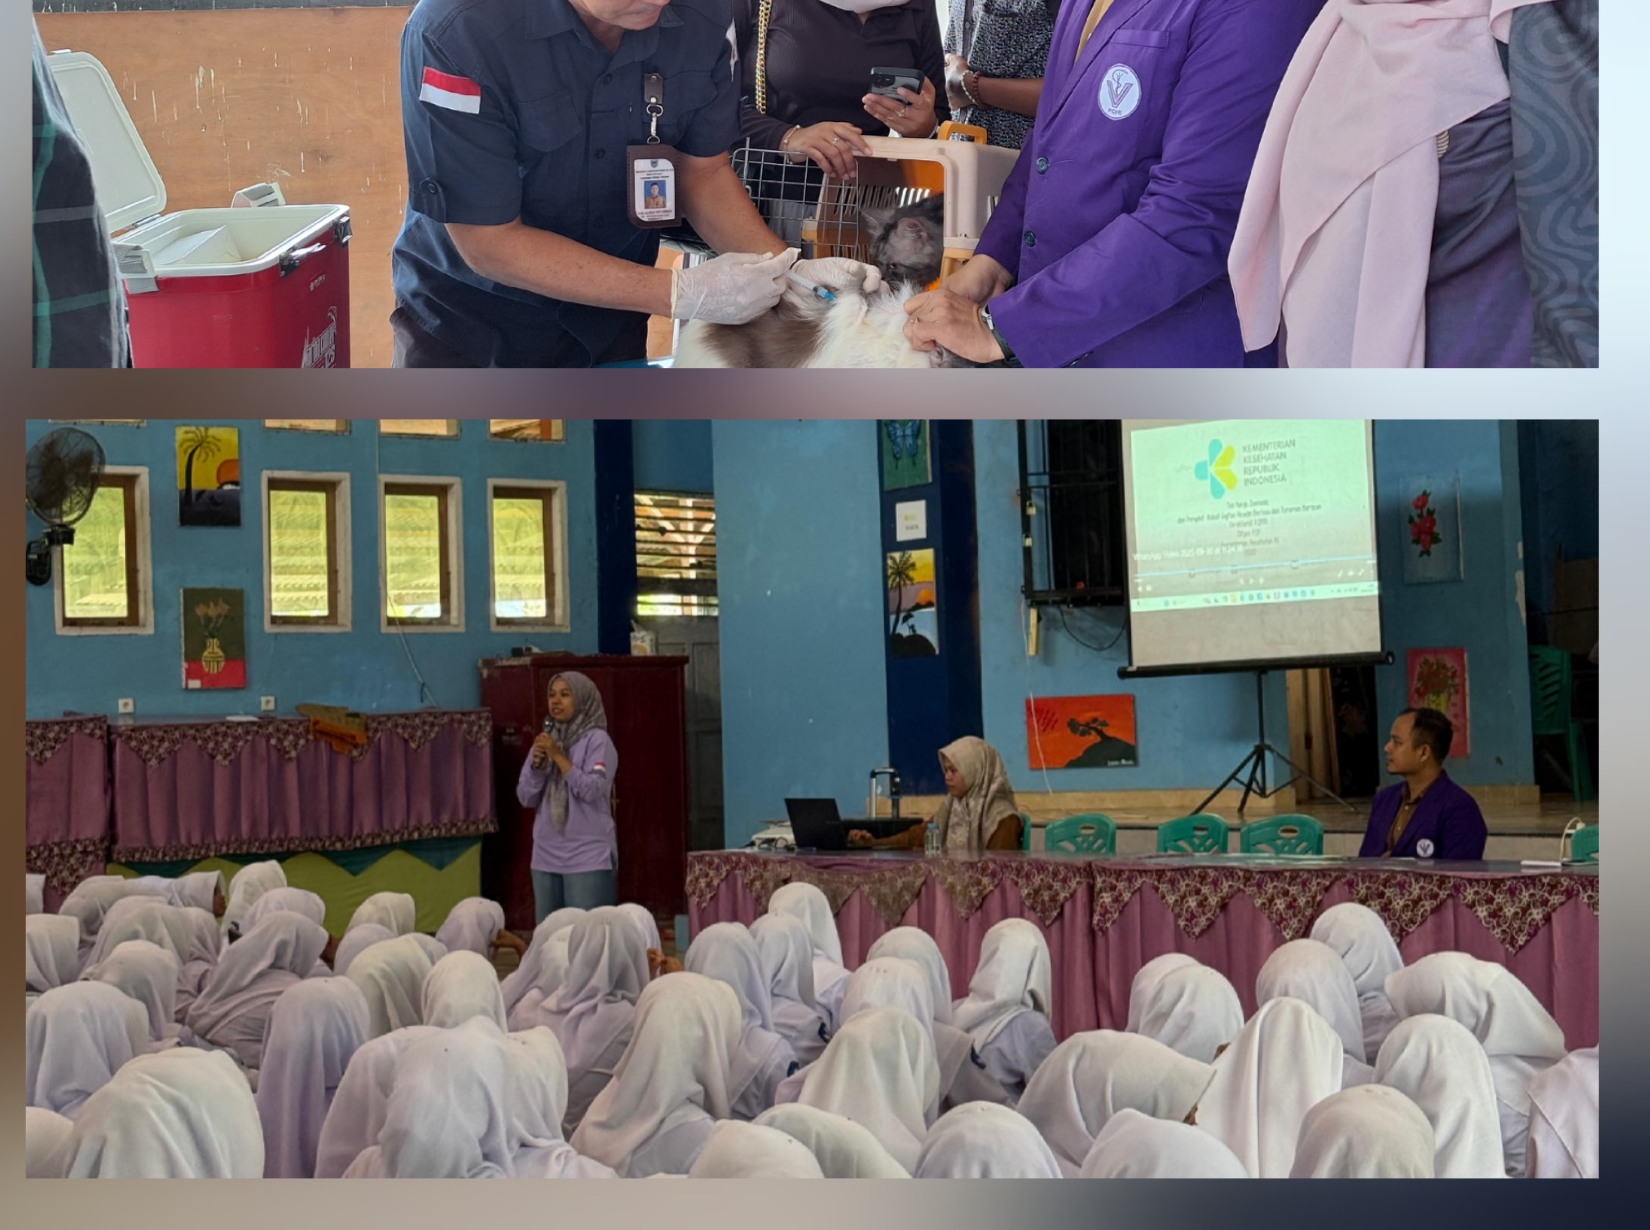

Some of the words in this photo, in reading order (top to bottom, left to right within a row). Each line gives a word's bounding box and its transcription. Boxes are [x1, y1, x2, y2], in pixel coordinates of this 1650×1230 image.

[1243, 439, 1296, 453] KEMENTERIAN
[1243, 452, 1287, 464] KESEHATAN
[1243, 464, 1280, 476] REPUBLIK
[1244, 474, 1287, 487] INDONESIA
